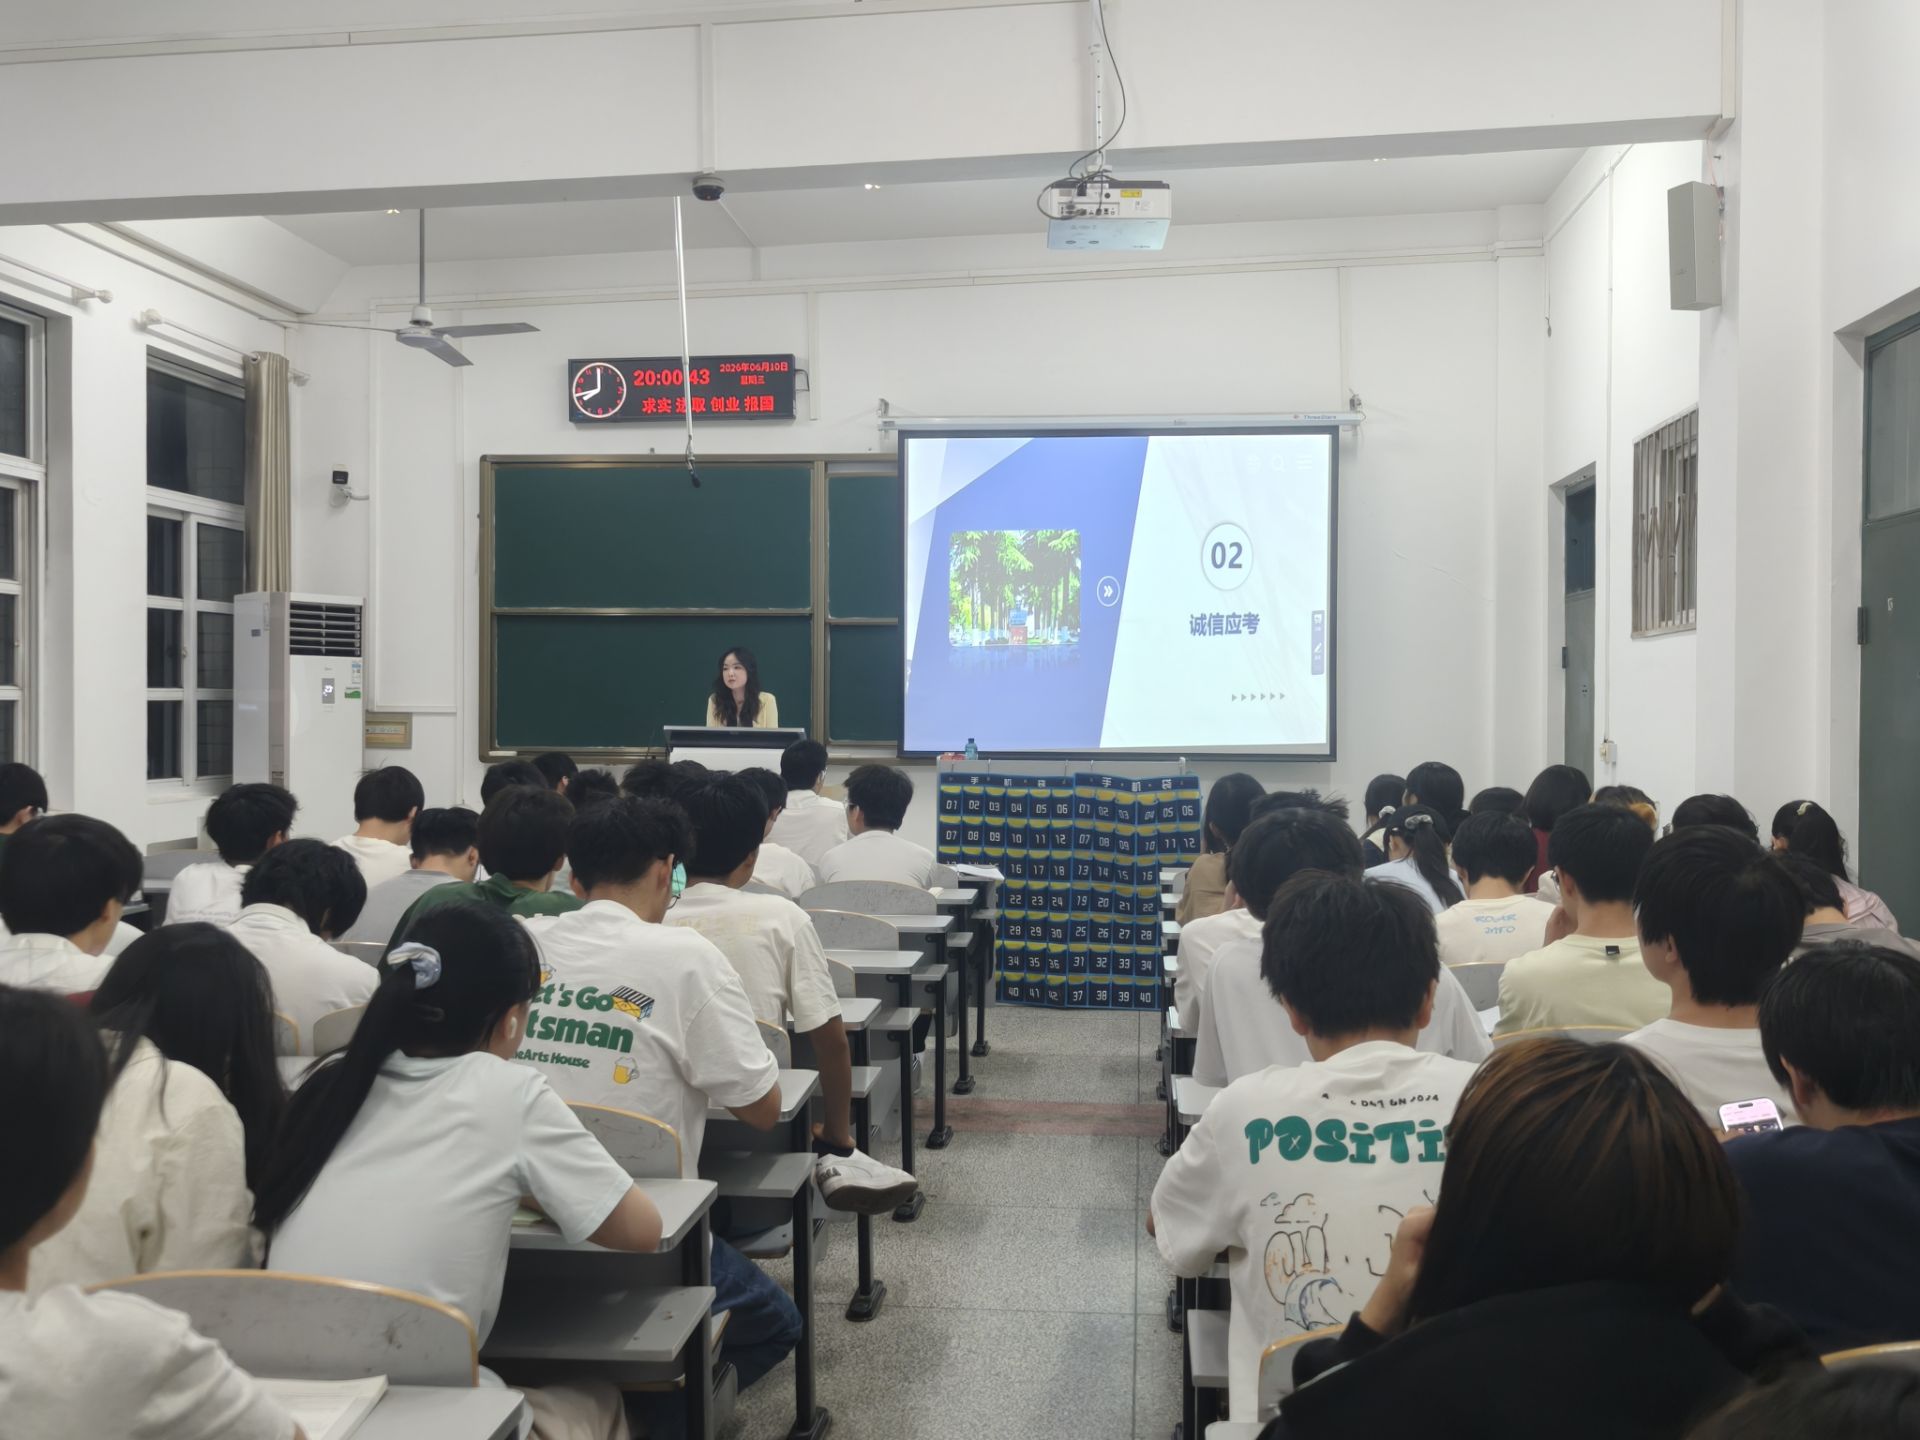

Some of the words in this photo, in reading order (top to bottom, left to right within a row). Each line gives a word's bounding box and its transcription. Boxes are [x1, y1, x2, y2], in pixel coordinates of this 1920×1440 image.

[633, 369, 710, 386] 20:0043
[642, 397, 672, 413] 求实
[711, 396, 740, 412] 创业
[744, 395, 774, 412] 报国
[1211, 542, 1243, 569] 02
[1190, 611, 1260, 636] 诚信应考
[946, 800, 958, 810] 01
[968, 799, 980, 810] 02
[989, 801, 1000, 812] 03
[1011, 803, 1022, 813] 04
[1036, 803, 1047, 814] 05
[1056, 803, 1068, 814] 06
[1079, 803, 1091, 814] 01
[1098, 806, 1109, 817] 02
[1118, 809, 1130, 820] 03
[1144, 811, 1155, 821] 04
[1162, 807, 1174, 818] 05
[1181, 805, 1194, 816] 06
[945, 830, 958, 840] 07
[967, 830, 979, 841] 08
[989, 831, 1001, 842] 09
[1012, 833, 1022, 844] 10
[1035, 834, 1046, 844] 11
[1055, 834, 1066, 845] 12
[1079, 834, 1091, 845] 07
[1099, 836, 1110, 848] 08
[1119, 840, 1130, 851] 09
[1144, 840, 1155, 851] 10
[1164, 838, 1176, 849] 11
[1183, 837, 1196, 849] 12
[1011, 863, 1022, 874] 16
[1033, 864, 1044, 875] 17
[1054, 865, 1065, 876] 18
[1078, 864, 1089, 876] 13
[1098, 866, 1109, 878] 14
[1118, 869, 1129, 880] 15
[1142, 871, 1153, 881] 16
[1009, 894, 1022, 905] 22
[1032, 895, 1044, 906] 23
[1052, 896, 1063, 907] 24
[1076, 895, 1088, 907] 19
[1097, 897, 1109, 908] 20
[1119, 901, 1131, 911] 21
[1142, 903, 1154, 913] 22
[1009, 925, 1021, 936] 28
[1030, 926, 1042, 937] 29
[1050, 928, 1062, 939] 30
[1075, 926, 1087, 937] 25
[1097, 927, 1109, 939] 26
[1118, 928, 1131, 940] 27
[1140, 930, 1152, 941] 28
[1007, 955, 1020, 967] 34
[1028, 957, 1040, 967] 35
[1048, 958, 1060, 970] 36
[1073, 956, 1085, 967] 31
[1095, 957, 1107, 969] 32
[1118, 958, 1131, 969] 33
[1141, 960, 1152, 971] 34
[531, 983, 575, 1008] et's
[576, 986, 614, 1012] Go
[1008, 987, 1019, 998] 40
[1029, 988, 1040, 999] 41
[1048, 989, 1059, 1001] 42
[1072, 990, 1083, 1001] 37
[1096, 990, 1107, 1001] 38
[1118, 991, 1130, 1002] 39
[1139, 992, 1152, 1003] 40
[526, 1009, 634, 1054] tsman
[550, 1052, 590, 1069] House
